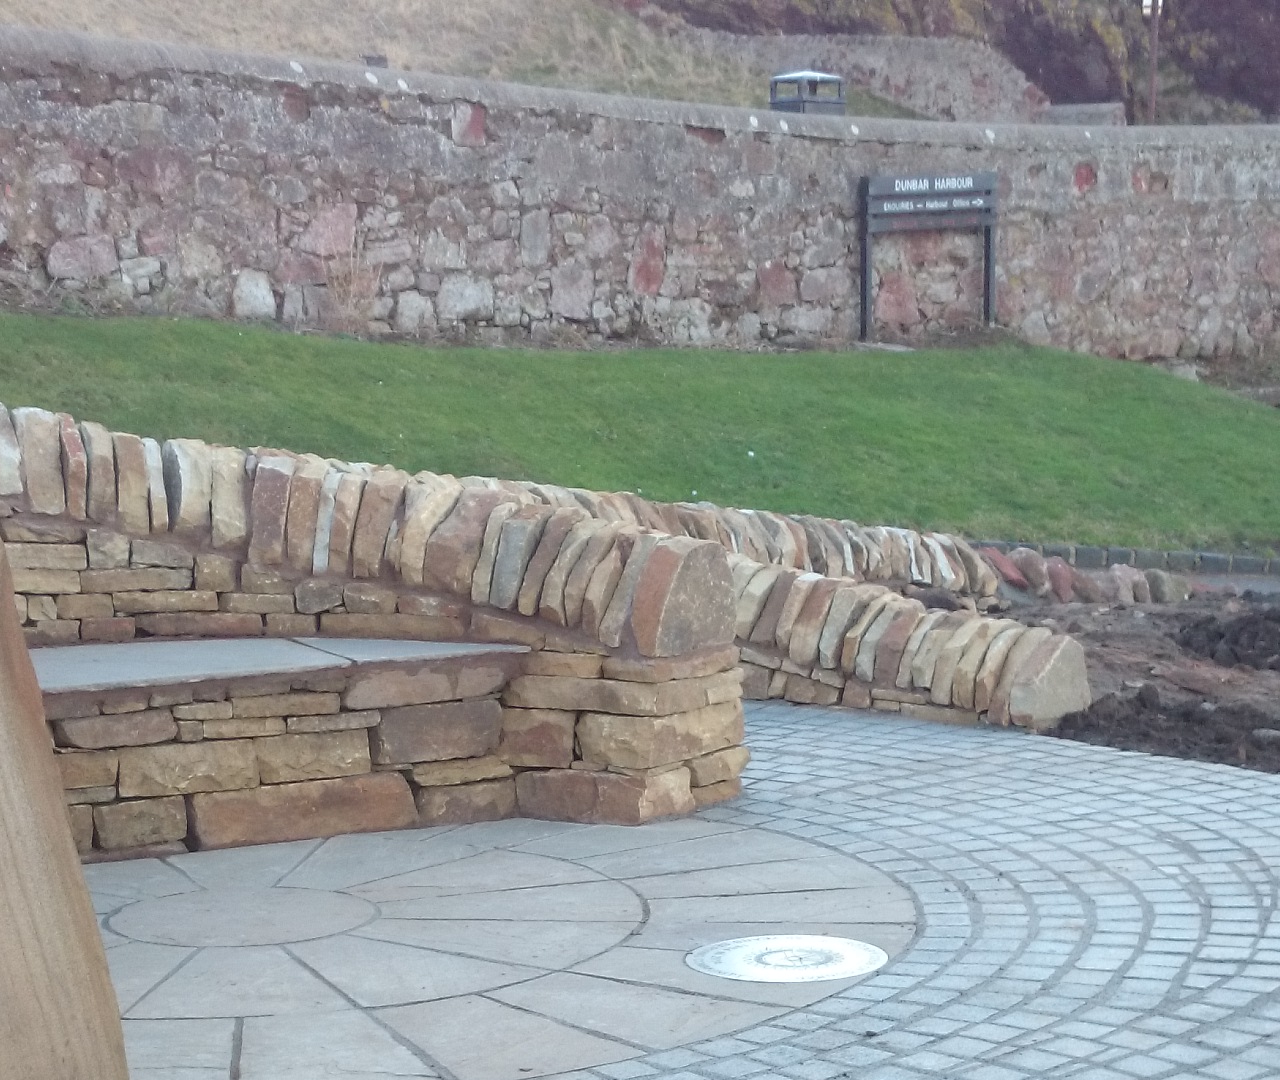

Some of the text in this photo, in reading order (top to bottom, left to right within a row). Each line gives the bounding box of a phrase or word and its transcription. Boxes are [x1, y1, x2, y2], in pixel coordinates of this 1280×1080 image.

[894, 177, 973, 191] DUNBAR HARBOUR
[925, 200, 948, 208] Harbour
